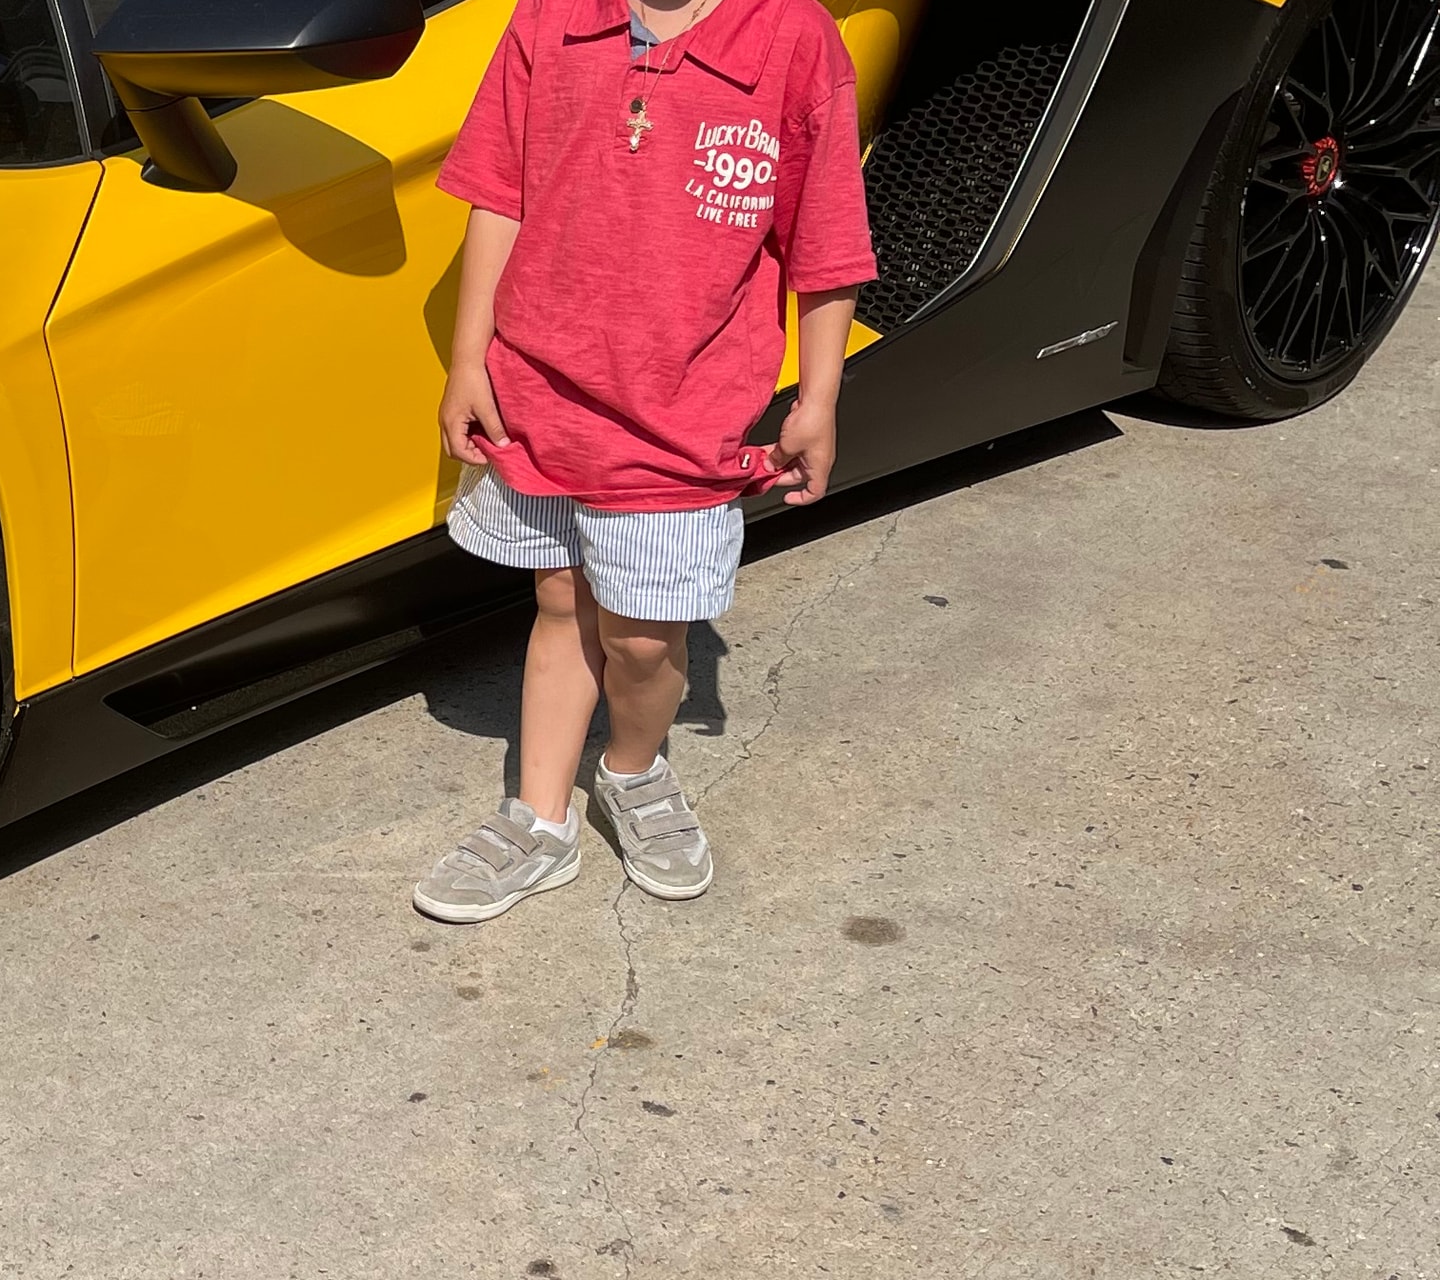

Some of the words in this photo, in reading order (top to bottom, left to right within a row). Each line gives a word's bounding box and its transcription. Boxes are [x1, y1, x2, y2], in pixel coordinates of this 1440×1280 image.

[744, 119, 780, 162] BRAN
[684, 179, 704, 200] L.A.
[696, 204, 724, 224] LIVE
[727, 212, 758, 228] FREE
